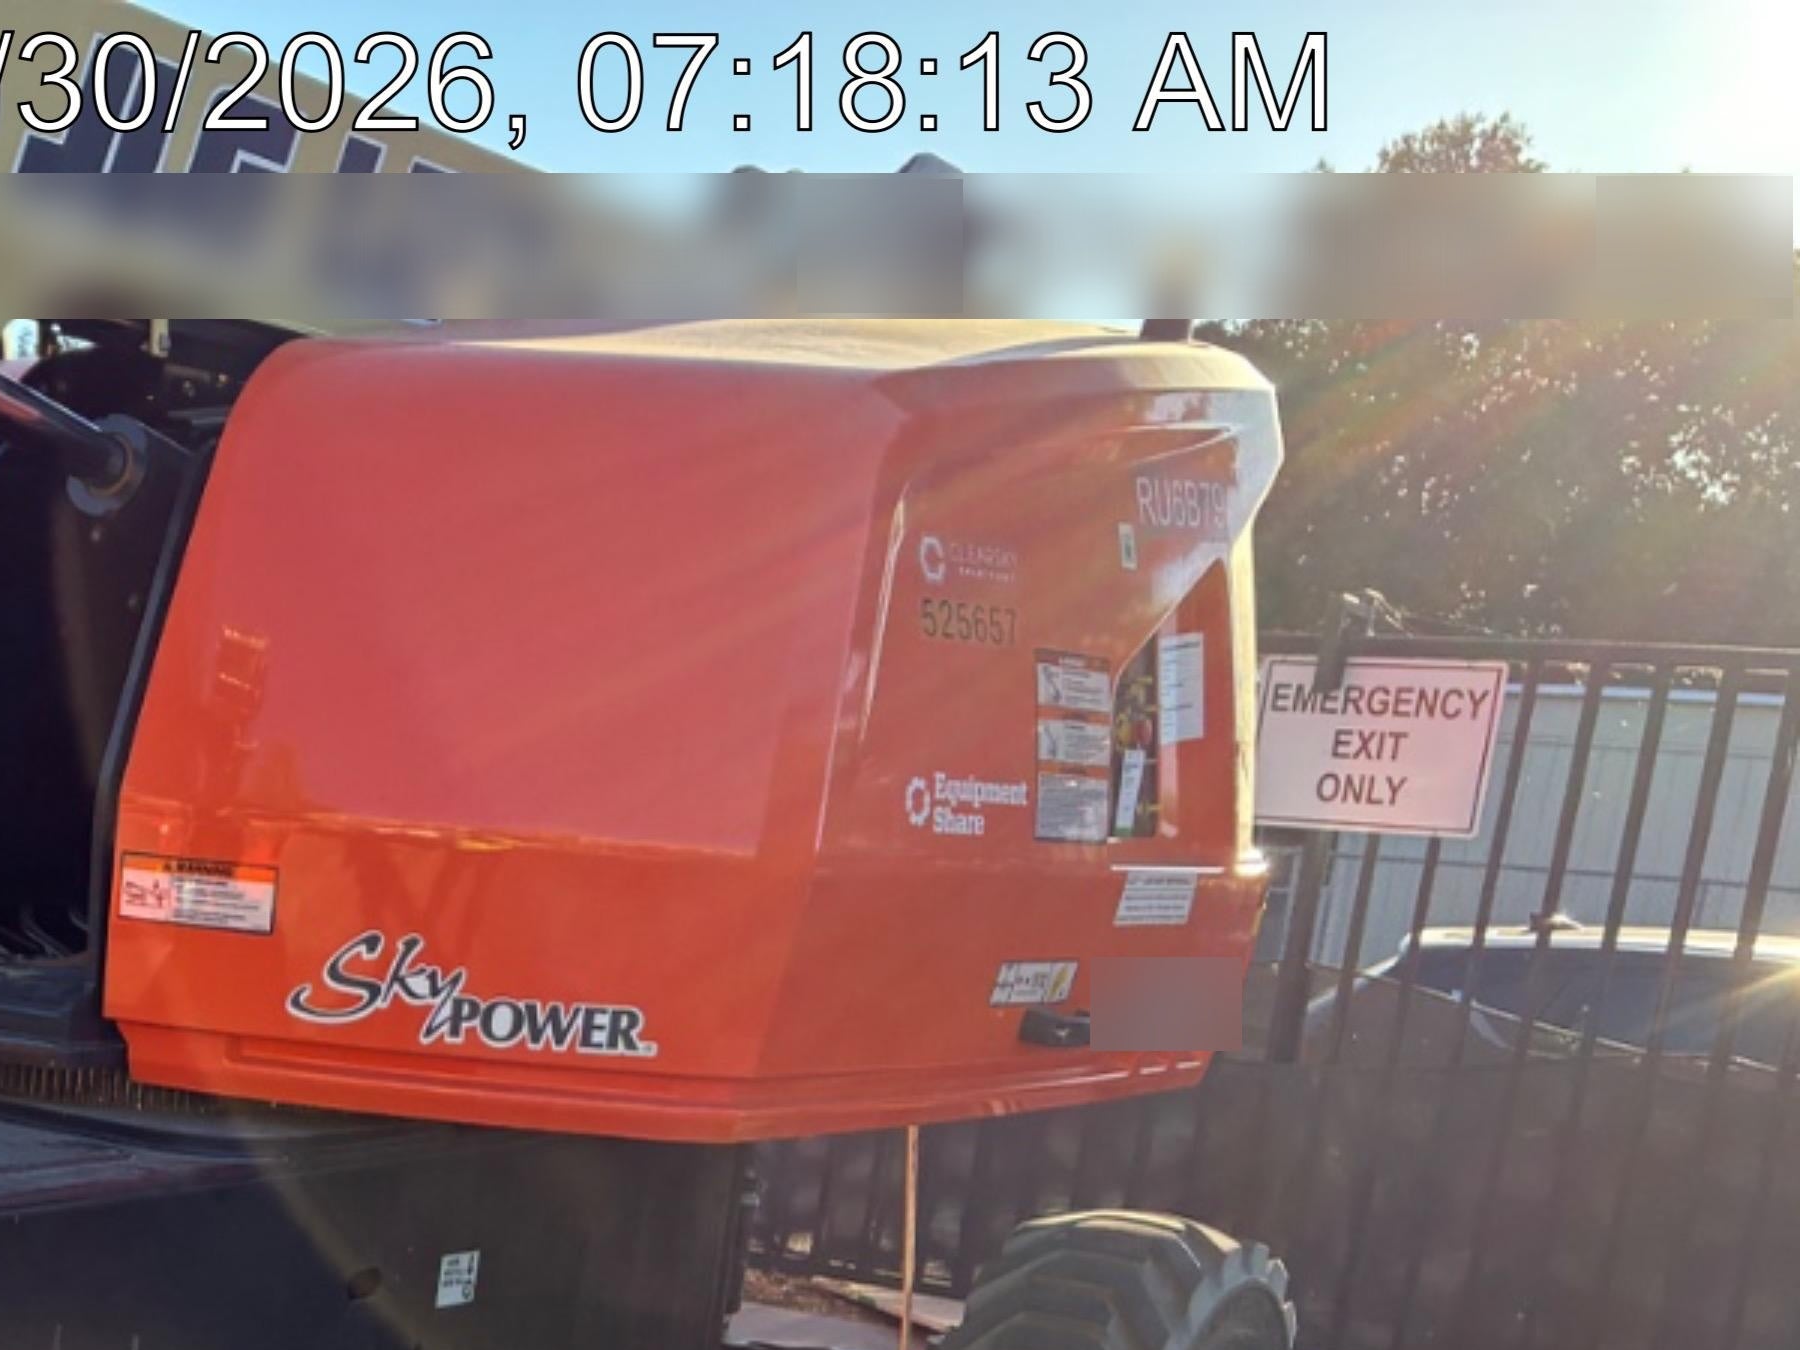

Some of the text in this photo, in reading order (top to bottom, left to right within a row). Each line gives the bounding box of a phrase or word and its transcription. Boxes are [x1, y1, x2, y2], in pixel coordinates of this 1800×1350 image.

[921, 597, 1017, 645] 525657
[1270, 683, 1490, 721] EMERGENCY
[1331, 728, 1409, 762] EXIT
[934, 771, 1027, 808] Equipment
[1316, 772, 1408, 806] ONLY
[933, 806, 985, 836] Share
[286, 929, 468, 1045] Sky
[443, 995, 644, 1053] POWER
